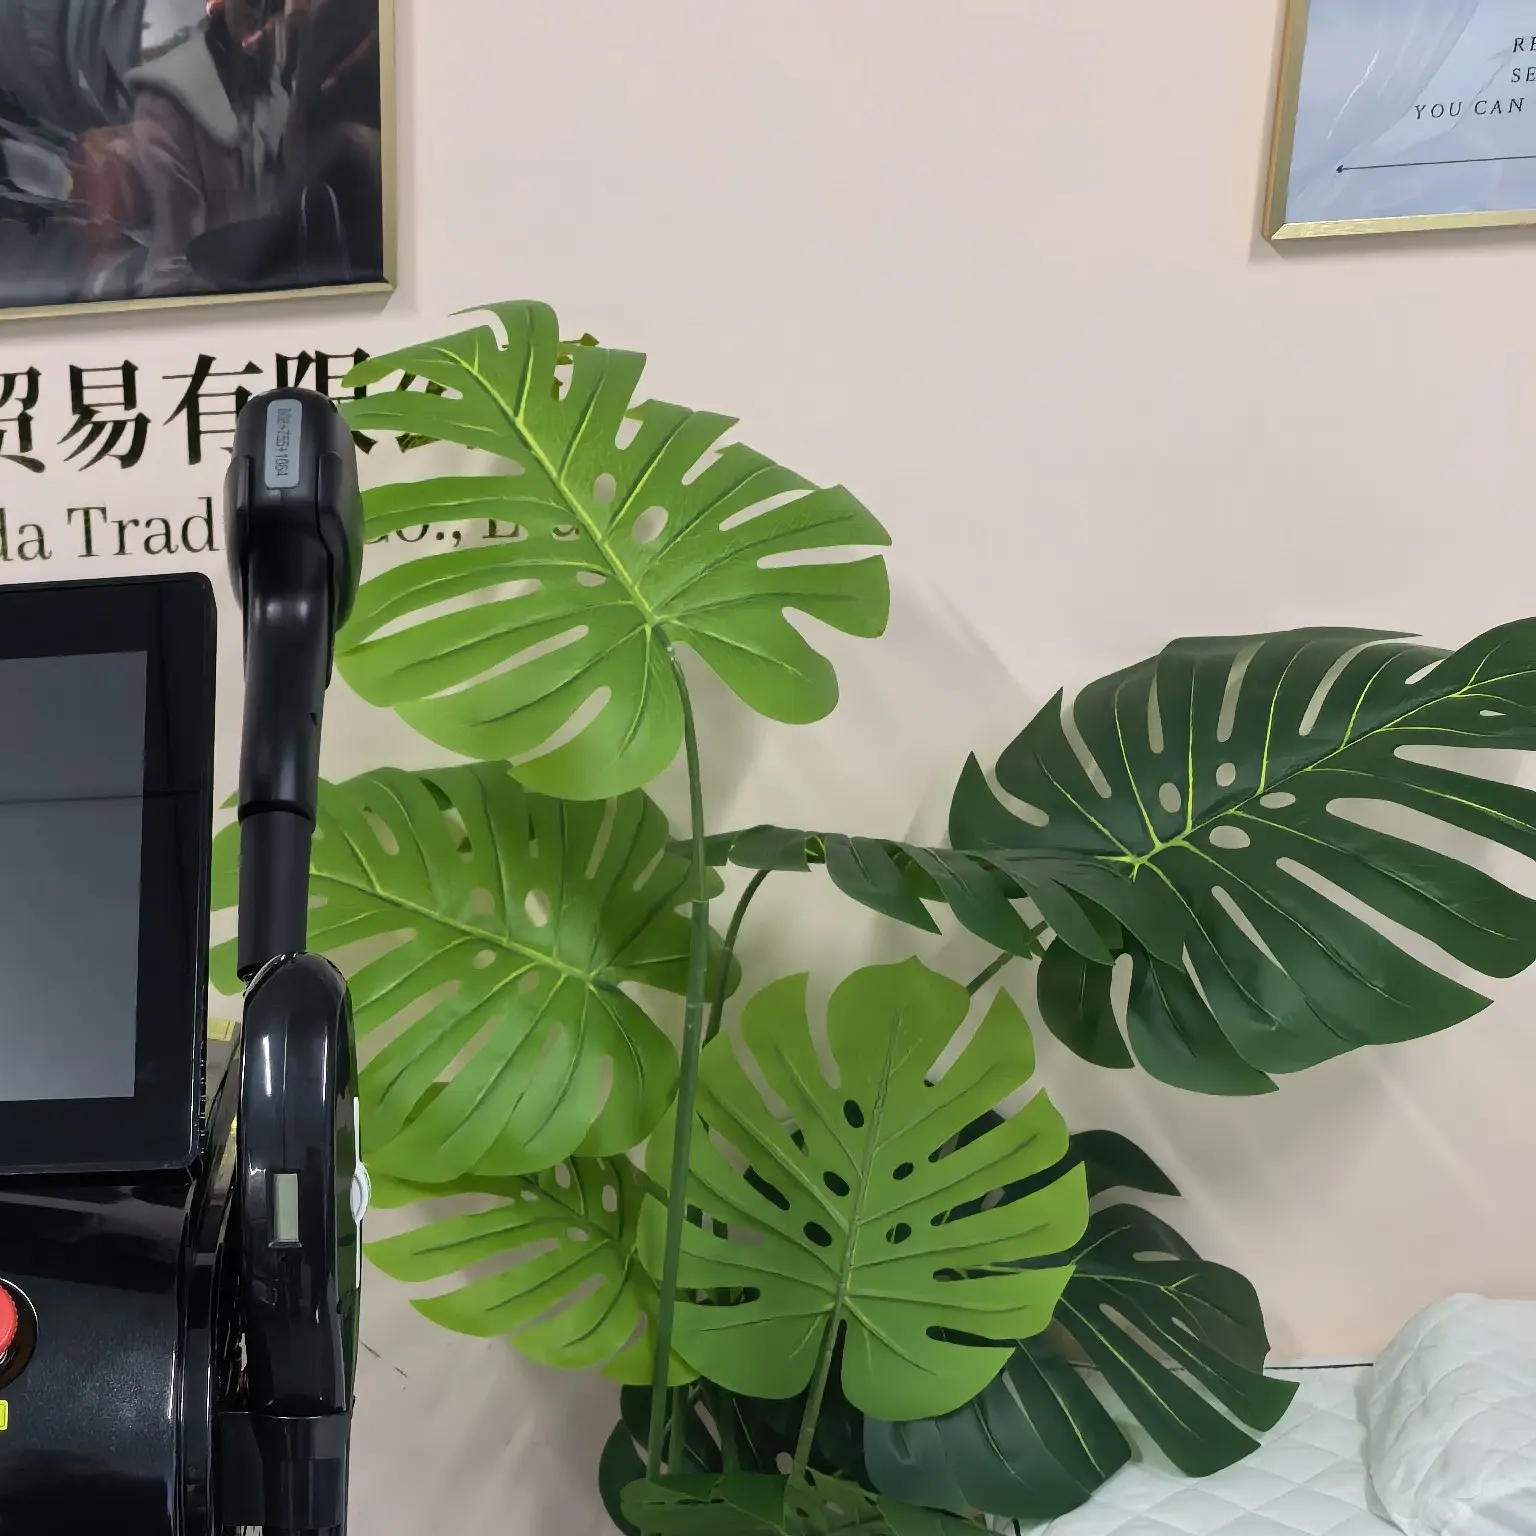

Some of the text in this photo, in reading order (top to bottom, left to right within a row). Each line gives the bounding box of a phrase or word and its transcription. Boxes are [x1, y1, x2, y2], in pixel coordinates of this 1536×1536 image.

[1414, 97, 1526, 120] YOU CAN
[67, 496, 221, 557] Trad
